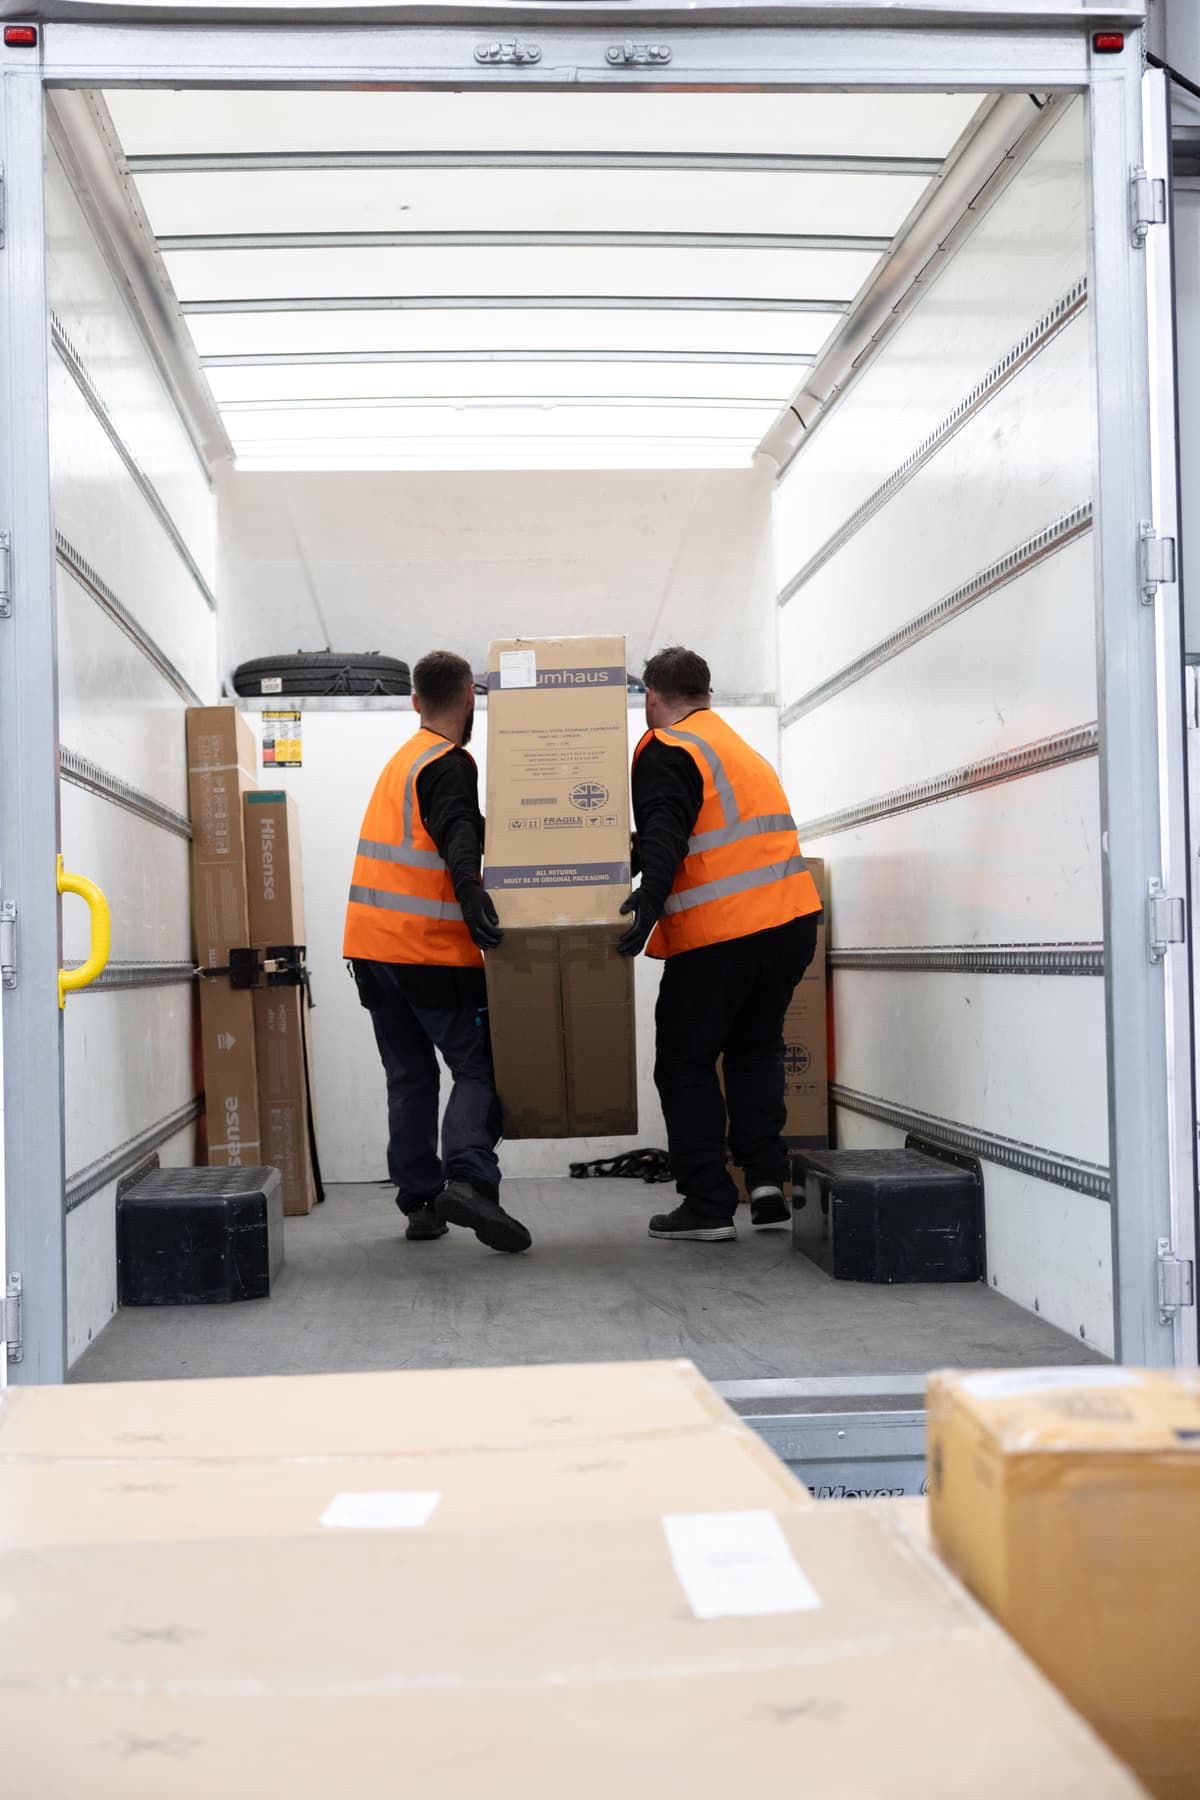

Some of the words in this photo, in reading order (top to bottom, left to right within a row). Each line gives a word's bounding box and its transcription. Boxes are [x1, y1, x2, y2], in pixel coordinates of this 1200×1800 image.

[544, 816, 583, 825] FRAGILE
[260, 818, 275, 900] Hisense
[541, 875, 571, 883] ORIGINAL
[573, 874, 610, 882] PACKAGING
